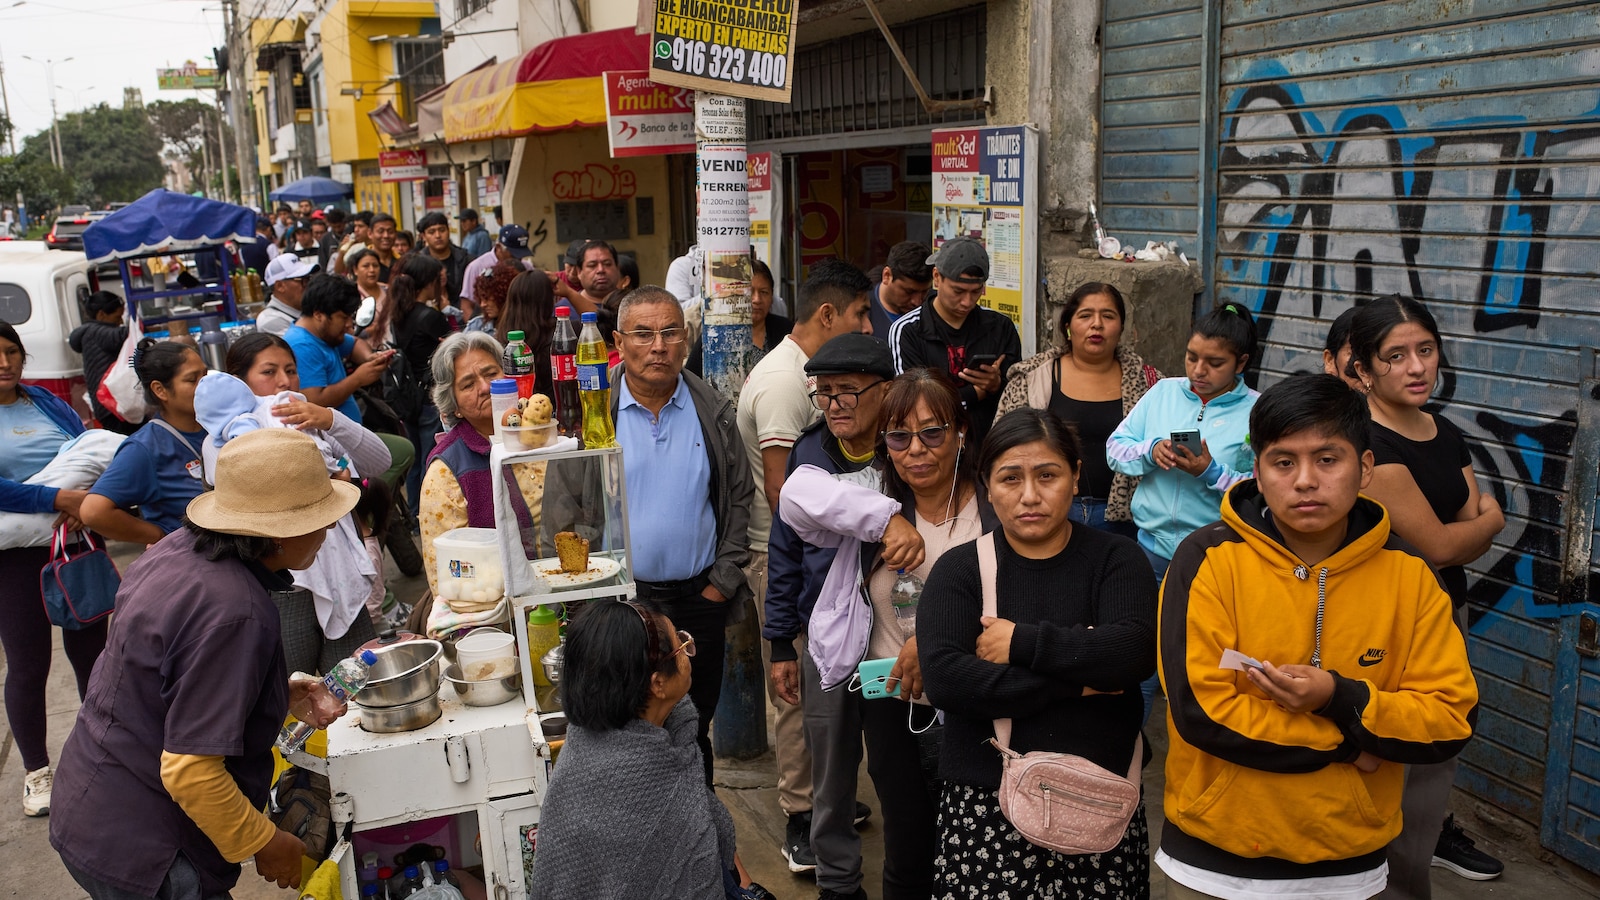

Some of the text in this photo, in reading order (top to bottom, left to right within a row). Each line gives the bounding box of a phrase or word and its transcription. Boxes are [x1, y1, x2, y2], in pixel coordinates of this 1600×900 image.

[659, 0, 788, 33] DE HUANCABAMBA
[656, 14, 788, 55] EXPERTO EN PAREJAS
[672, 37, 787, 87] 916 323 400
[618, 87, 695, 111] multiRe
[709, 98, 725, 106] Con
[640, 123, 666, 133] Banco
[668, 122, 679, 132] de
[680, 122, 688, 131] la
[934, 134, 976, 156] multiRed
[986, 131, 1020, 156] TRÁMITES
[702, 159, 748, 172] VEND
[940, 157, 969, 169] VIRTUAL
[998, 158, 1020, 178] DE DNI
[703, 182, 748, 192] TERREN
[992, 181, 1020, 202] VIRTUAL
[1365, 648, 1388, 658] NIKE
